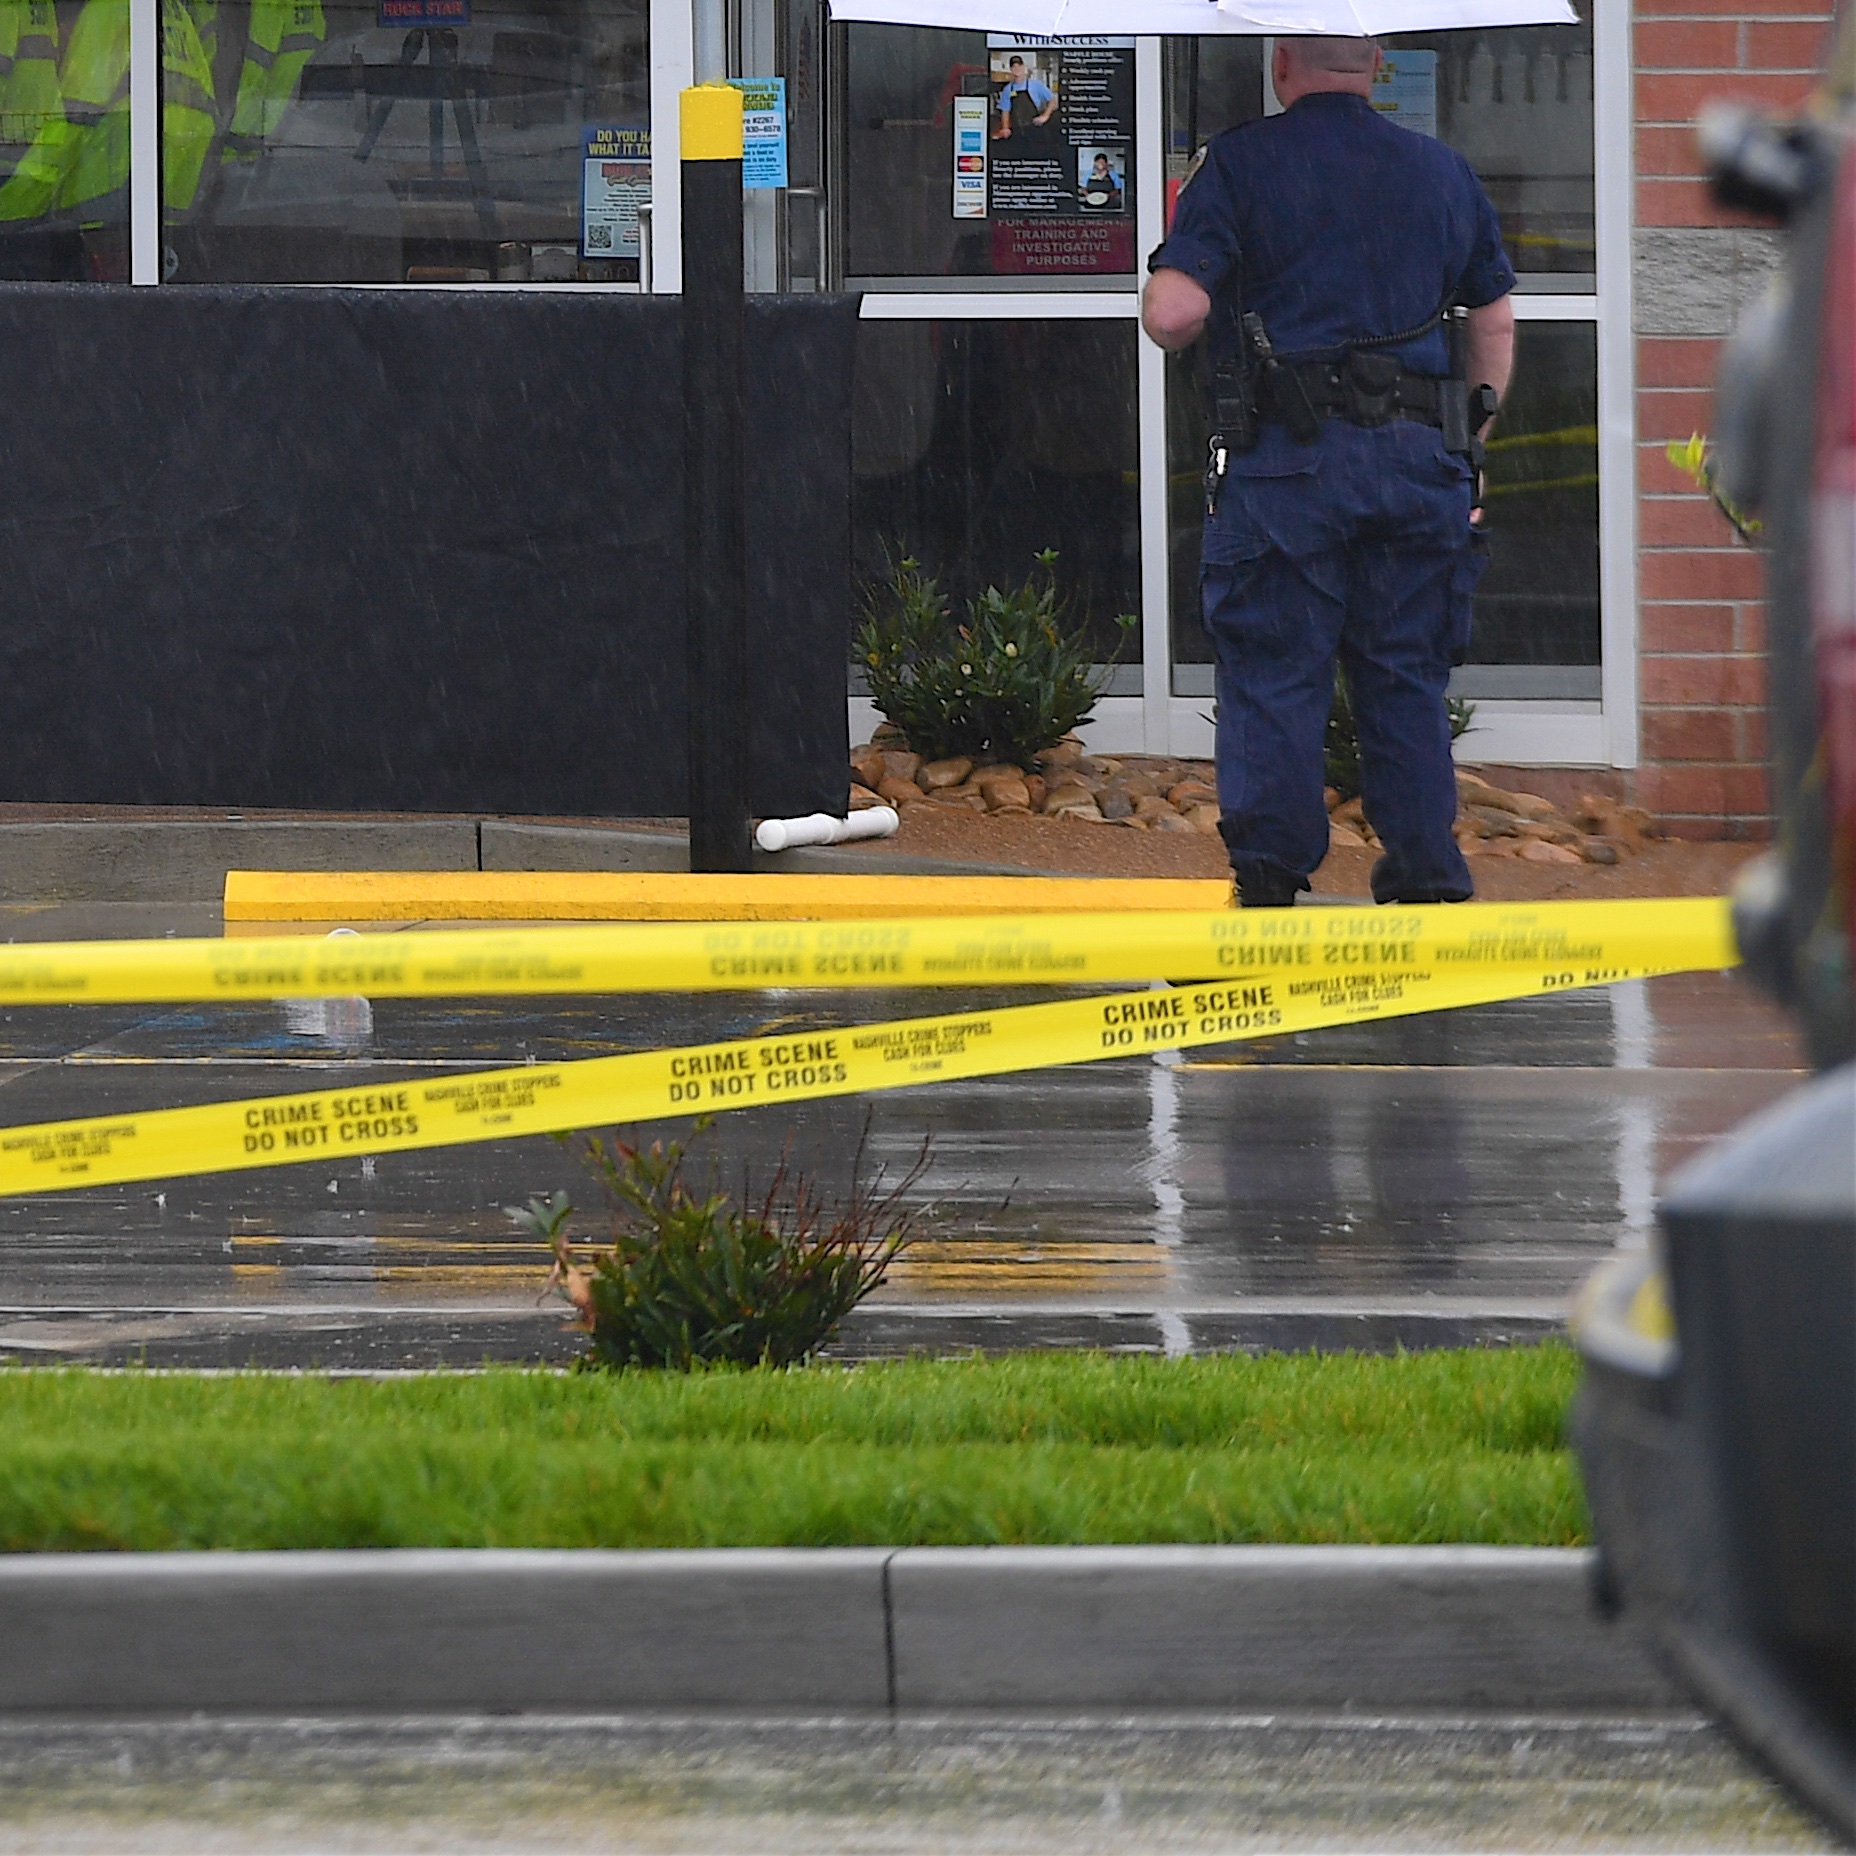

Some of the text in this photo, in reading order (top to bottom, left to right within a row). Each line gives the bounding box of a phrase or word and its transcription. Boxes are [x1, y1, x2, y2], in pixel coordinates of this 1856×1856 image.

[588, 143, 652, 156] WHAT IT TA
[597, 130, 612, 143] DO
[616, 130, 637, 143] YOU
[1012, 241, 1111, 253] INVESTIGATIVE
[1014, 229, 1108, 240] TRAINING AND
[1026, 255, 1097, 266] PURPOSES
[1103, 985, 1274, 1026] CRIME SCENE
[1101, 1009, 1281, 1047] DO NOT CROSS
[670, 1039, 840, 1078] CRIME SCENE
[669, 1063, 847, 1102] DO NOT CROSS
[245, 1090, 410, 1129] CRIME SCENE
[243, 1115, 419, 1153] DO NOT CROSS
